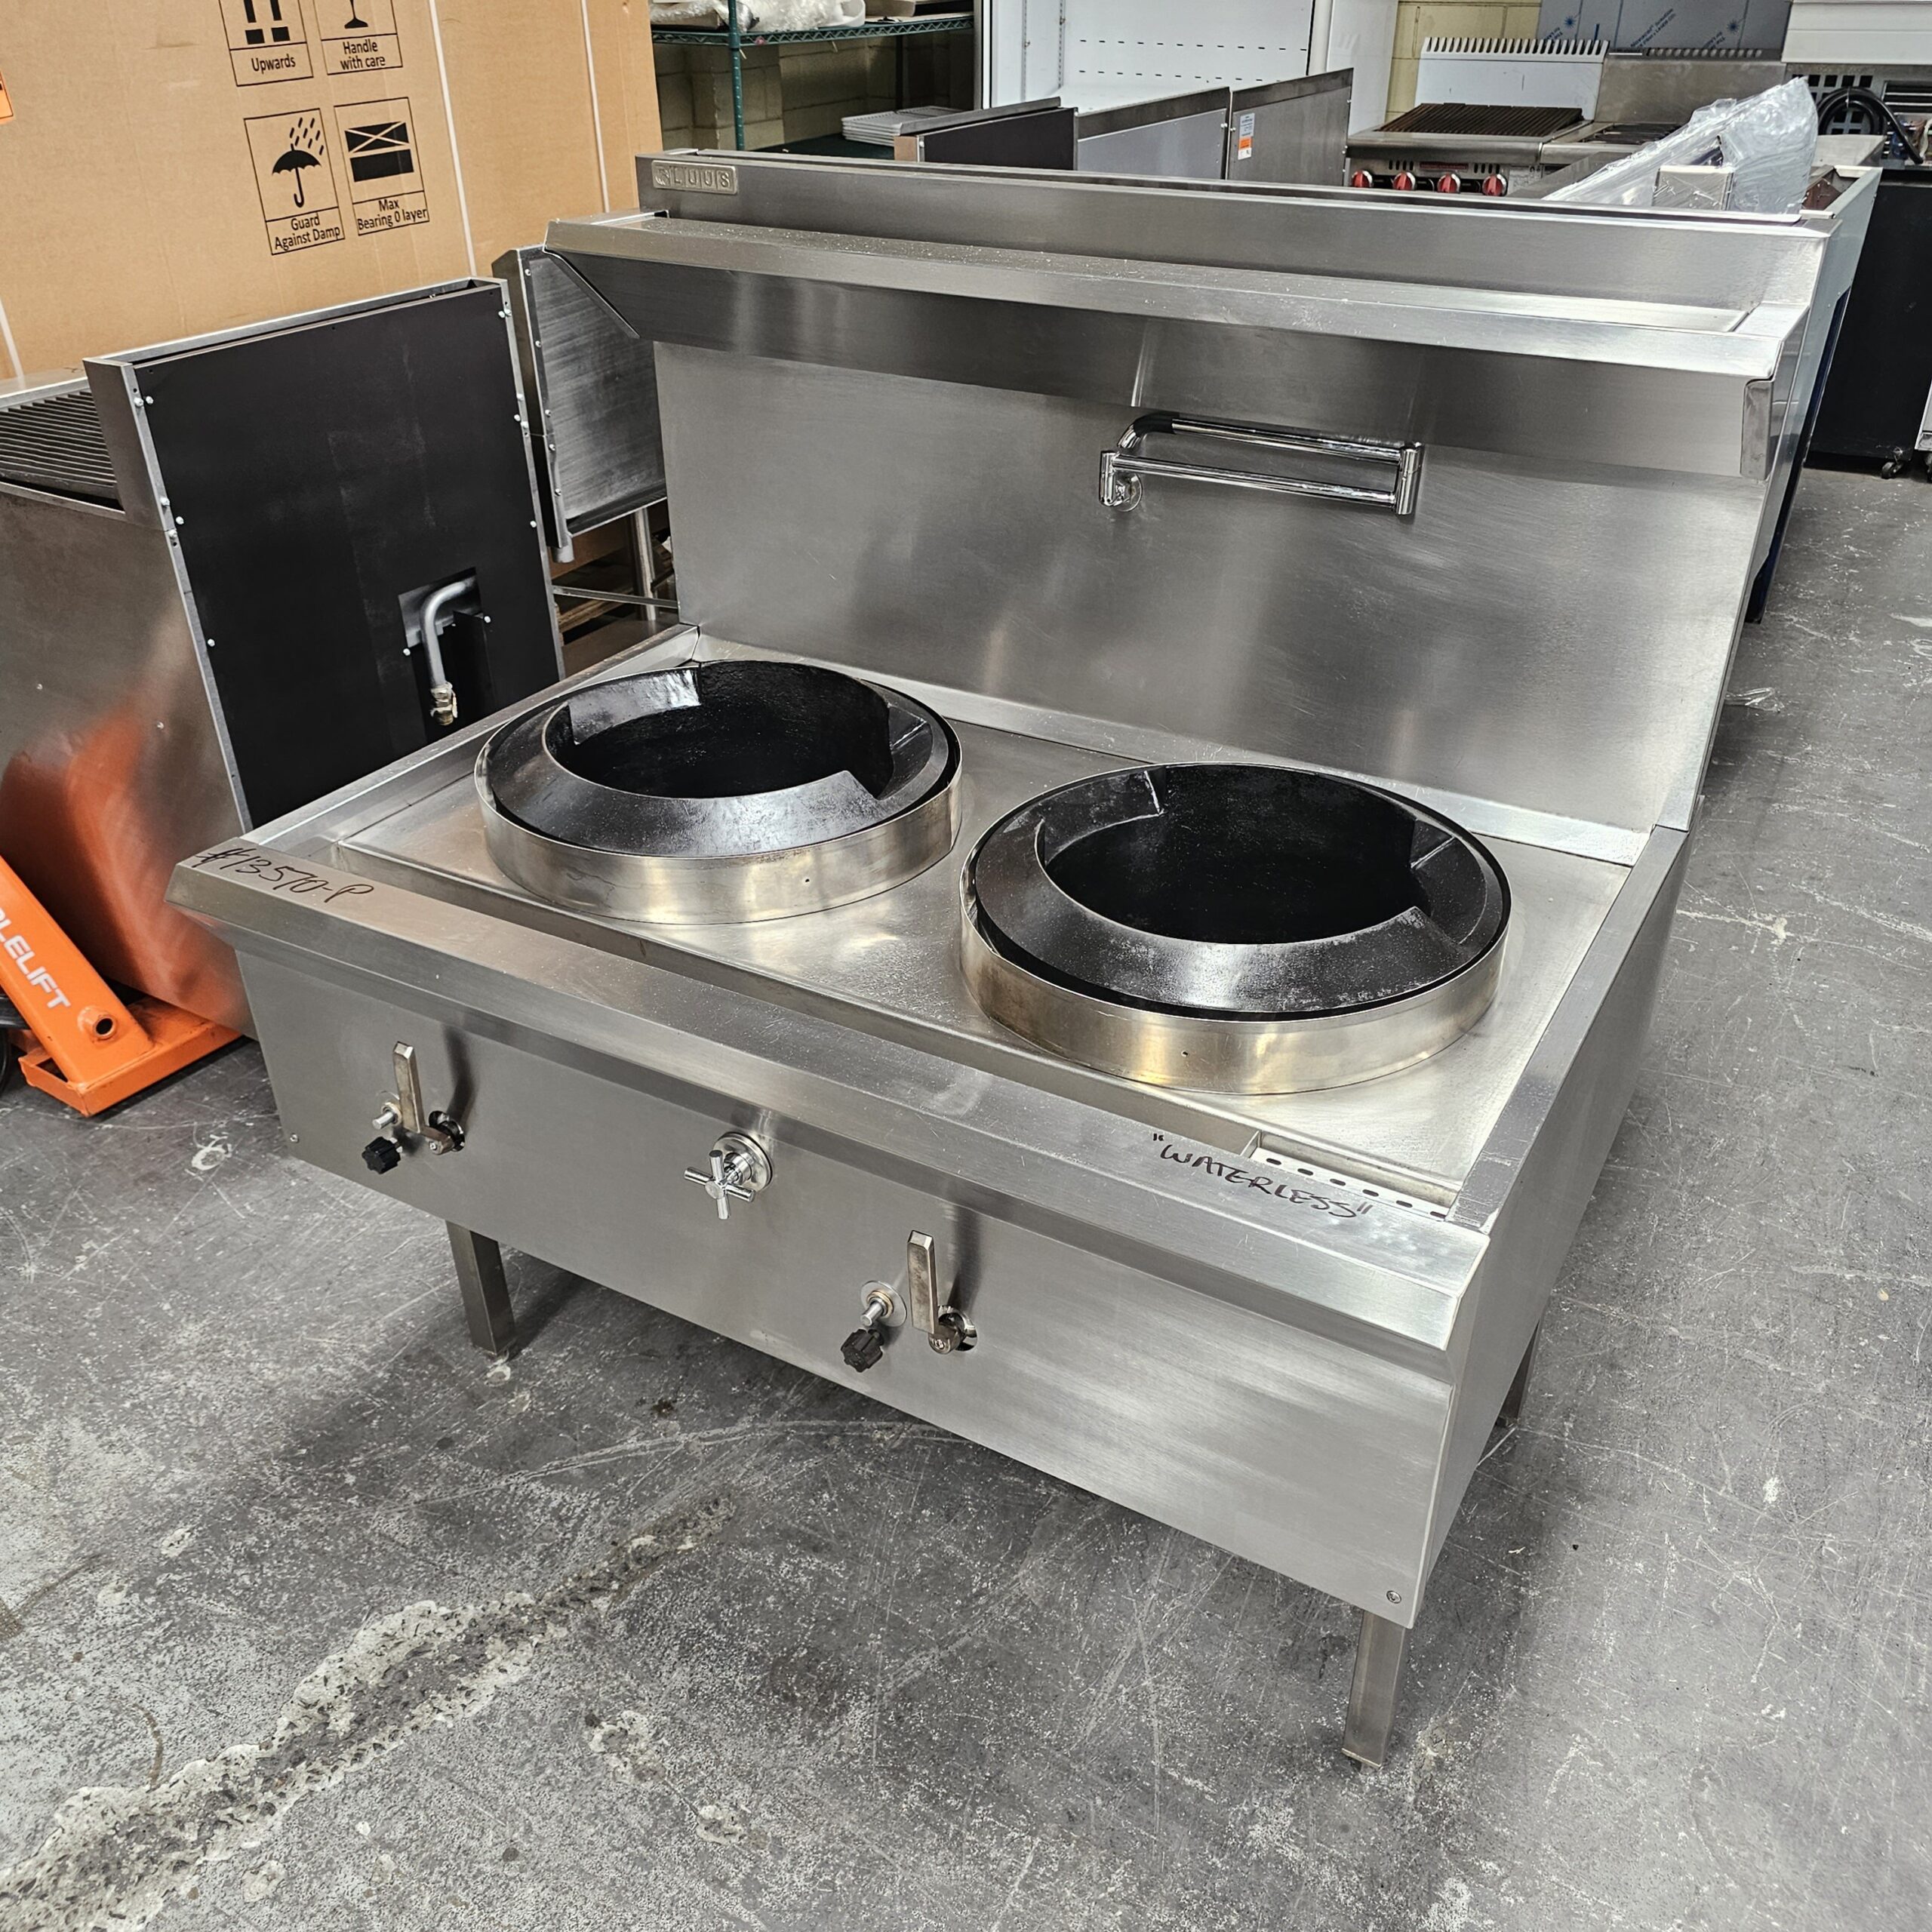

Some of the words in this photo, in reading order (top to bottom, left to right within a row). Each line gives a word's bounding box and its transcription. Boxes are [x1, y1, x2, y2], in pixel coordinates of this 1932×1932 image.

[343, 40, 378, 55] Handle
[251, 54, 296, 74] Upwards
[340, 57, 362, 70] with
[365, 56, 386, 68] care
[673, 166, 731, 188] LUUS
[379, 199, 400, 211] Max
[291, 214, 320, 230] Guard
[357, 214, 392, 230] Bearing
[403, 208, 427, 222] layer
[275, 232, 312, 251] Against
[313, 226, 340, 242] Damp
